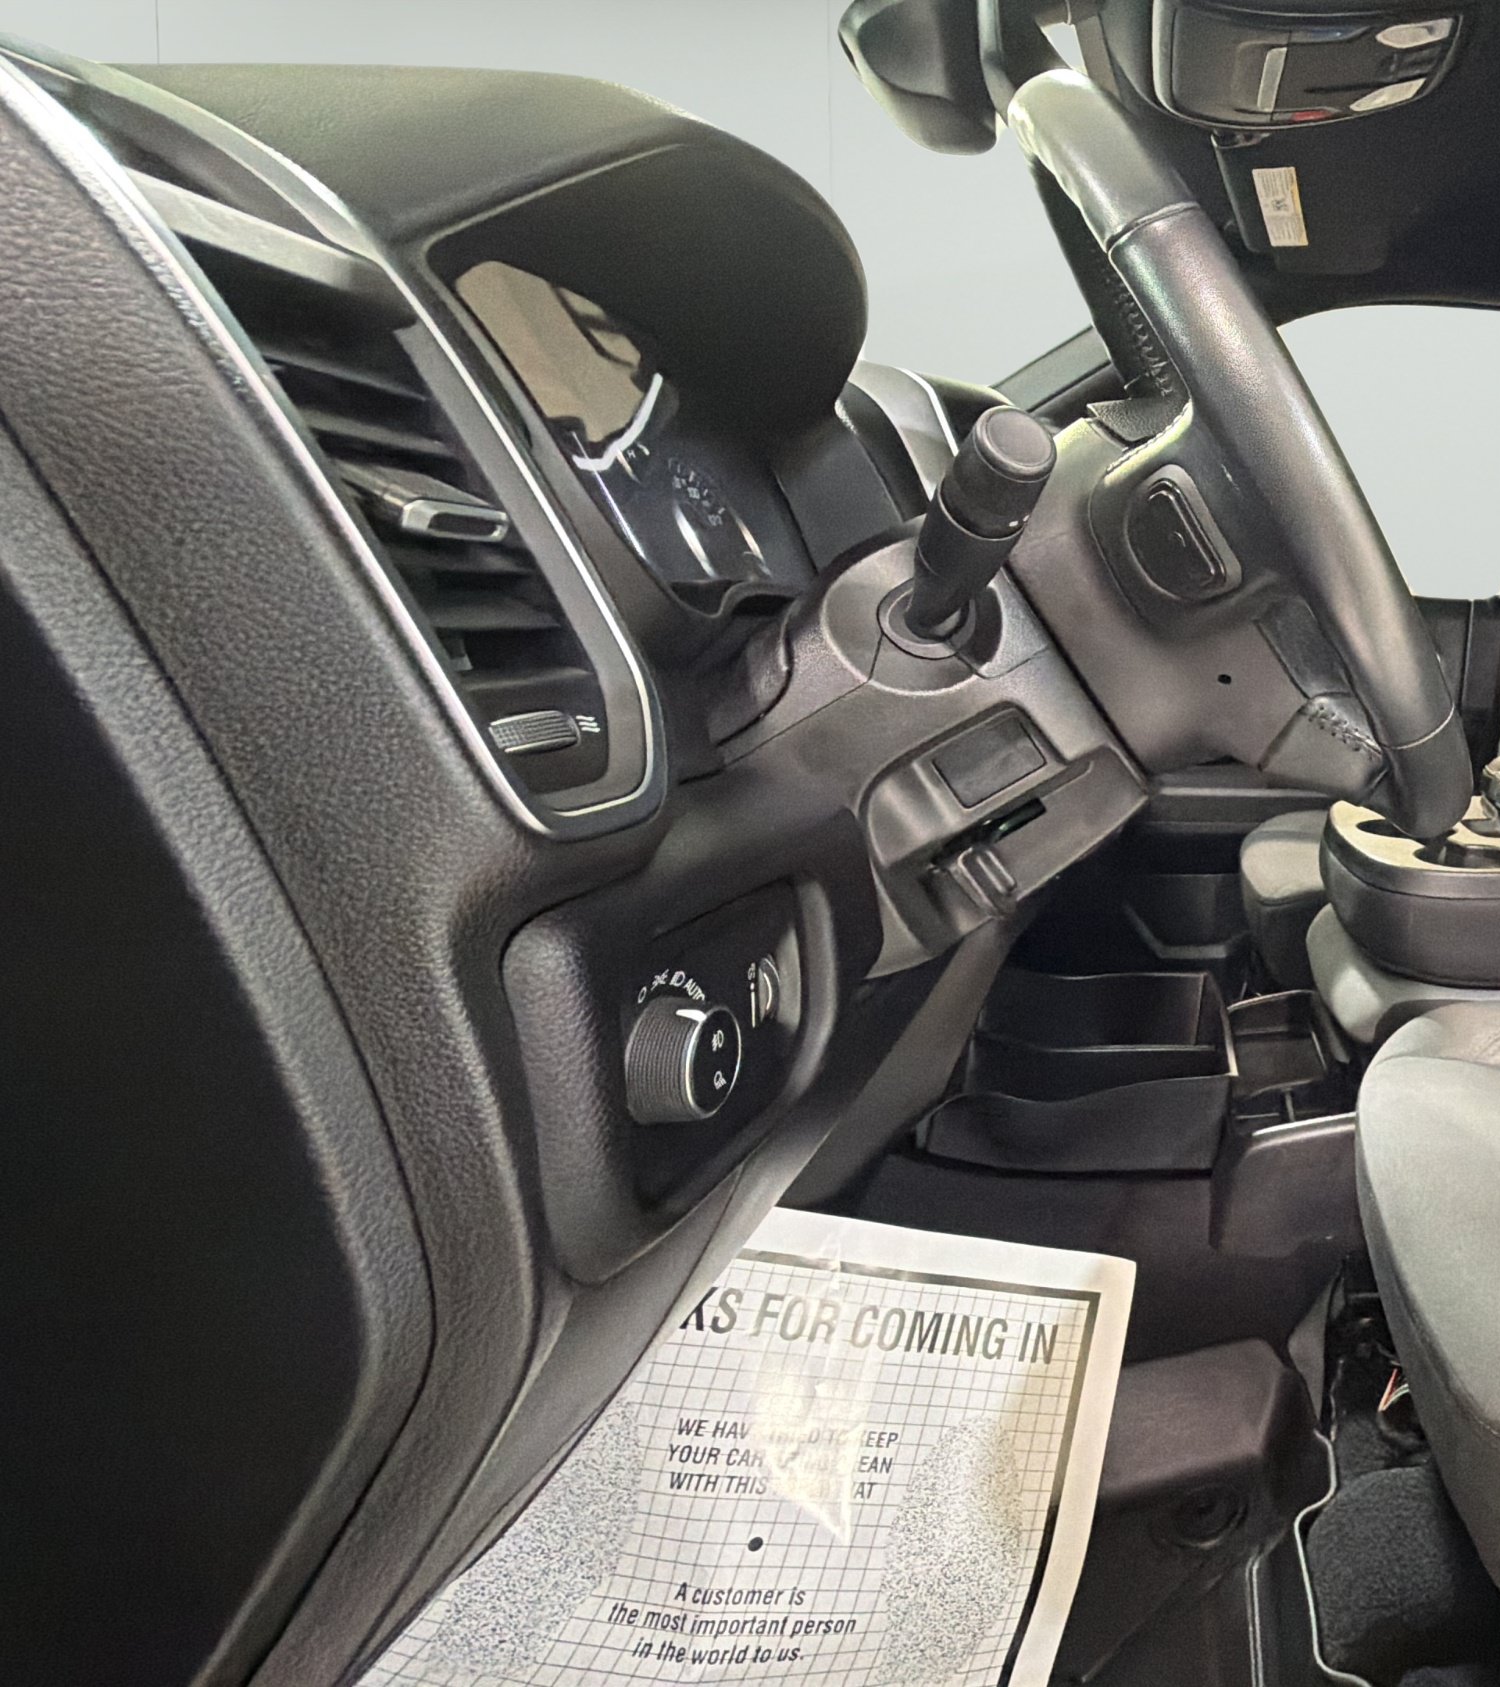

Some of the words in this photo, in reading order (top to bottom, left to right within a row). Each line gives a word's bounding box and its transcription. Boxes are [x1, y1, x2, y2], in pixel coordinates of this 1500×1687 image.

[750, 1288, 842, 1346] FOR
[850, 1303, 1009, 1361] COMING
[1017, 1321, 1059, 1365] IN
[677, 1418, 708, 1438] WE
[712, 1420, 753, 1440] HAV
[668, 1443, 720, 1466] YOUR
[726, 1448, 766, 1468] CAR
[669, 1471, 720, 1493] WITH
[722, 1474, 770, 1495] THIS
[673, 1581, 688, 1600] A
[692, 1588, 784, 1606] customer
[788, 1586, 806, 1606] is
[607, 1602, 639, 1625] the
[643, 1610, 688, 1632] most
[690, 1615, 789, 1639] important
[790, 1617, 856, 1639] person
[632, 1637, 653, 1659] in
[656, 1640, 685, 1664] the
[691, 1644, 750, 1665] world
[752, 1645, 770, 1664] to
[777, 1646, 805, 1663] us.
